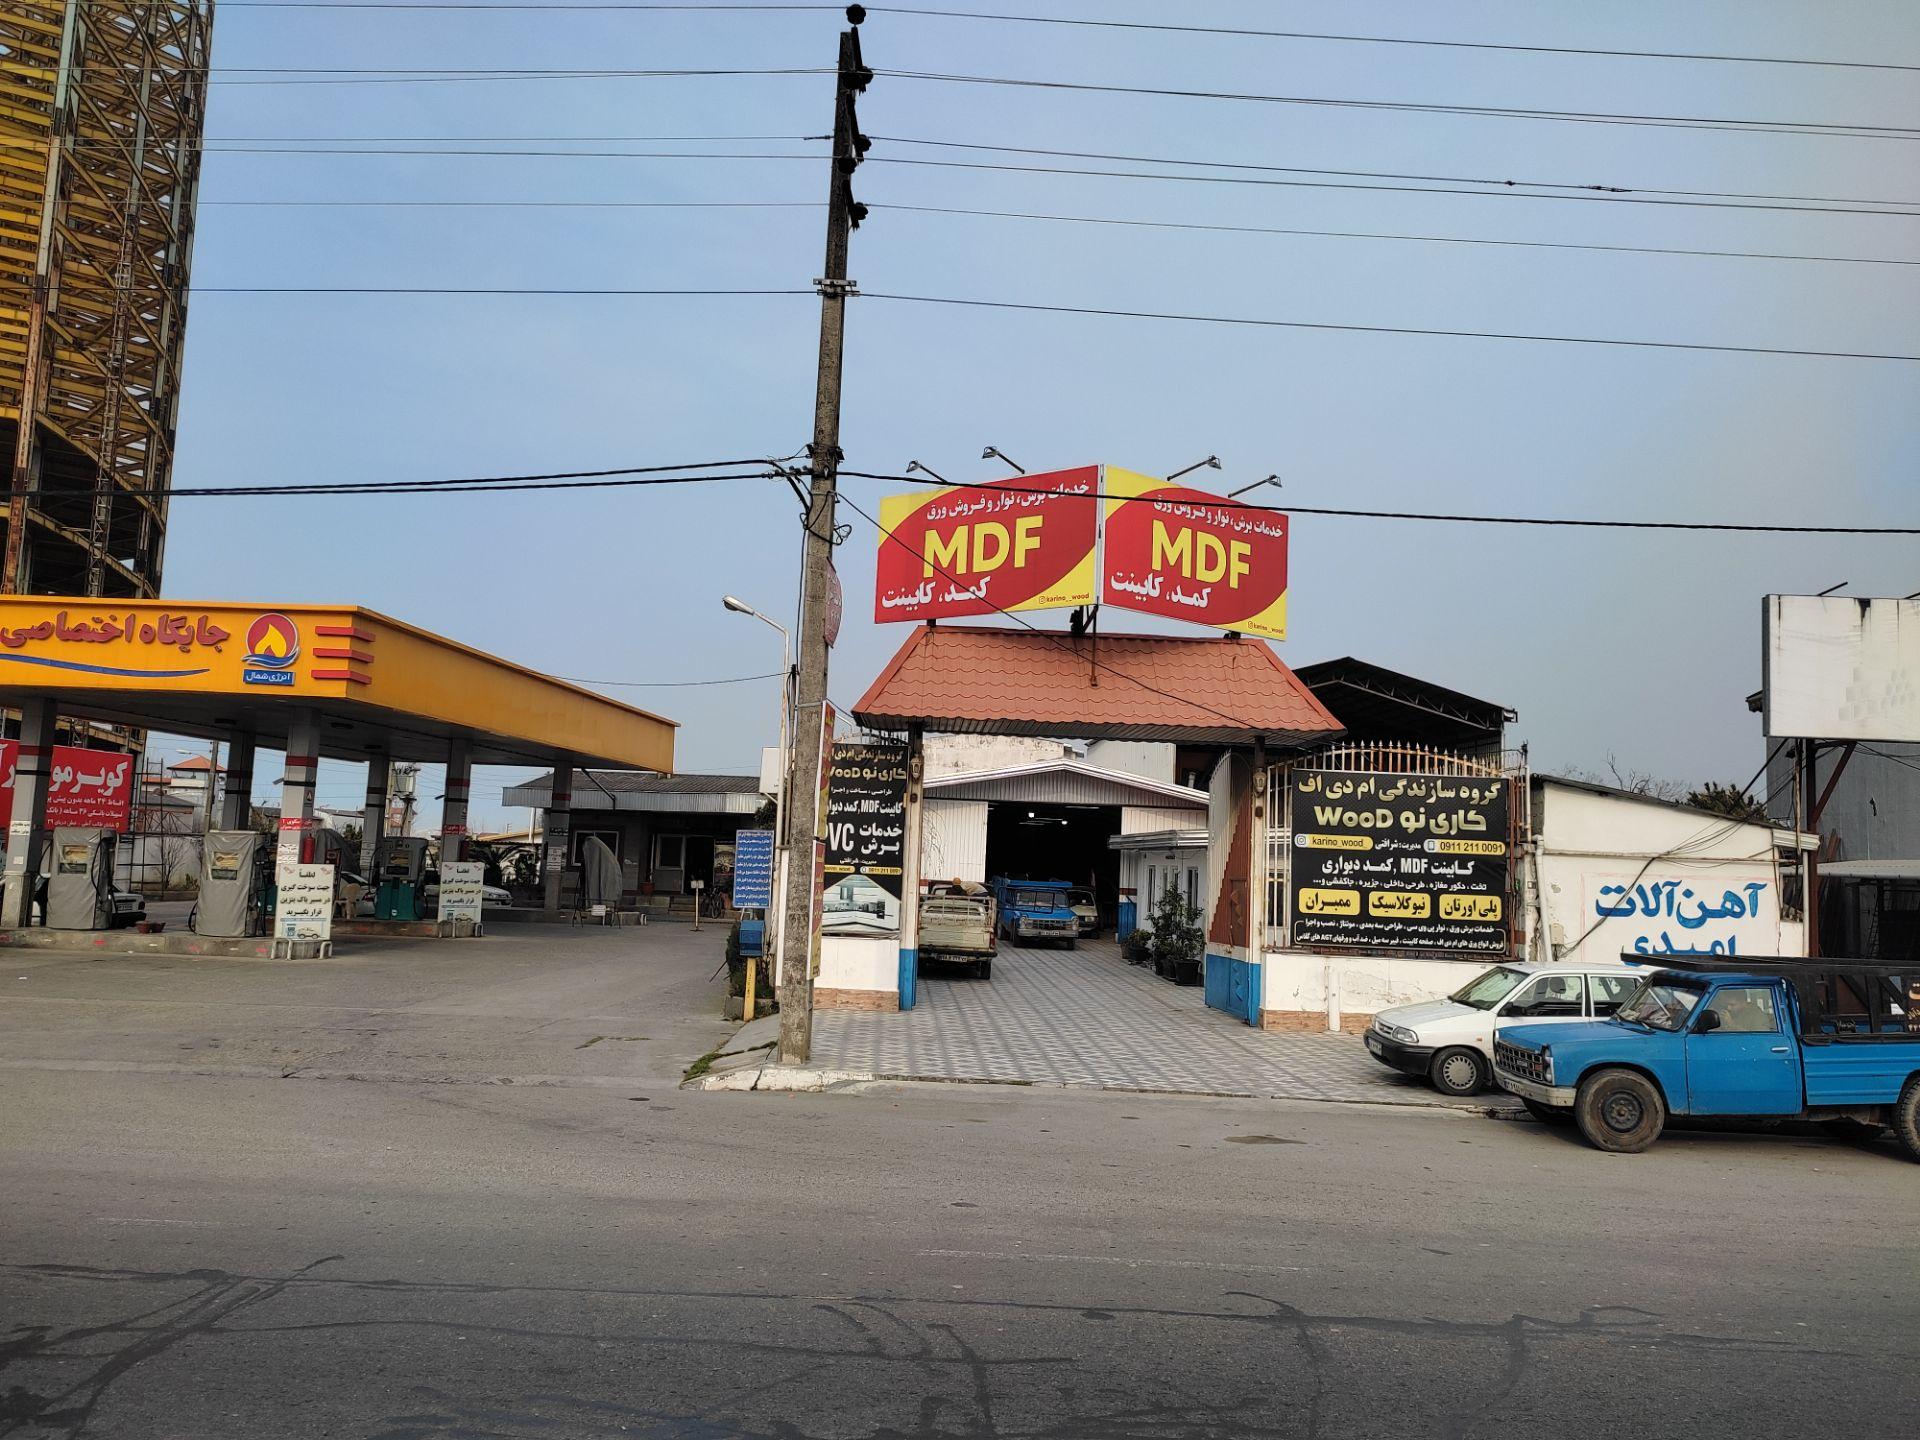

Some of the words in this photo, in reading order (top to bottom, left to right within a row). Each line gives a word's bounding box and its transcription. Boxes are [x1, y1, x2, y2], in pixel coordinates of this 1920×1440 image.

[1049, 479, 1089, 499] خدمات
[949, 494, 986, 518] فروش
[987, 501, 993, 513] و
[995, 491, 1015, 512] نوار
[926, 504, 946, 521] ورق
[1173, 499, 1206, 520] فروش
[1206, 512, 1212, 524] و
[1212, 509, 1230, 528] نوار
[1253, 519, 1284, 539] خدمات
[923, 514, 1044, 579] MDF
[1151, 519, 1252, 590] MDF
[1110, 571, 1164, 601] کابینت
[881, 581, 937, 611] کابینت
[0, 610, 137, 648] اختصاصی
[139, 613, 231, 654] جایگاه
[245, 671, 269, 683] شمال
[269, 671, 291, 683] انرژی
[833, 749, 847, 761] دی
[846, 749, 855, 761] ام
[855, 749, 886, 763] سازندگی
[886, 750, 904, 763] گروه
[69, 761, 128, 797] کویر
[862, 766, 878, 780] نو
[878, 767, 907, 782] کاری
[1298, 772, 1322, 793] اف
[1325, 778, 1354, 800] دی
[1357, 776, 1375, 801] ام
[831, 786, 846, 795] اجرا
[849, 786, 868, 795] ساخت
[1378, 778, 1456, 804] سازندگی
[1459, 782, 1502, 805] گروه
[861, 800, 880, 813] MDF
[880, 801, 903, 817] کابینت
[1400, 806, 1427, 834] نو
[1428, 809, 1487, 836] کاری
[859, 822, 903, 837] خدمات
[860, 838, 900, 855] برش
[1440, 842, 1462, 852] 0911
[1463, 843, 1480, 852] 211
[1481, 843, 1504, 853] 0091
[1321, 855, 1361, 875] دیواری
[1400, 858, 1428, 874] MDF
[1430, 860, 1475, 878] کابینت
[297, 884, 315, 893] سوخت
[1326, 877, 1354, 886] جاکفشی
[1358, 877, 1380, 888] جزیره
[1383, 878, 1404, 888] داخلی
[1429, 881, 1448, 890] مغازه
[1449, 881, 1466, 891] دکور
[1470, 883, 1487, 891] تخت
[317, 885, 330, 893] جهت
[1305, 891, 1351, 911] ممبران
[1595, 879, 1683, 918] آلات
[1675, 882, 1768, 929] آهن
[1444, 898, 1477, 917] اورتان
[1478, 899, 1498, 919] پلی
[1305, 918, 1316, 927] اجرا
[1320, 919, 1336, 927] نصب
[1339, 920, 1356, 929] مونتاژ
[1359, 922, 1375, 930] بعدی
[1384, 922, 1403, 931] طراحی
[1436, 923, 1446, 933] نوار
[1449, 925, 1460, 934] ورق
[1474, 925, 1495, 933] خدمات
[1460, 926, 1474, 934] برش
[1402, 937, 1419, 946] کابینت
[1451, 939, 1458, 948] ام
[1457, 939, 1468, 948] های
[1468, 940, 1478, 949] ورق
[1478, 940, 1489, 949] انواع
[1489, 941, 1504, 949] فروش
